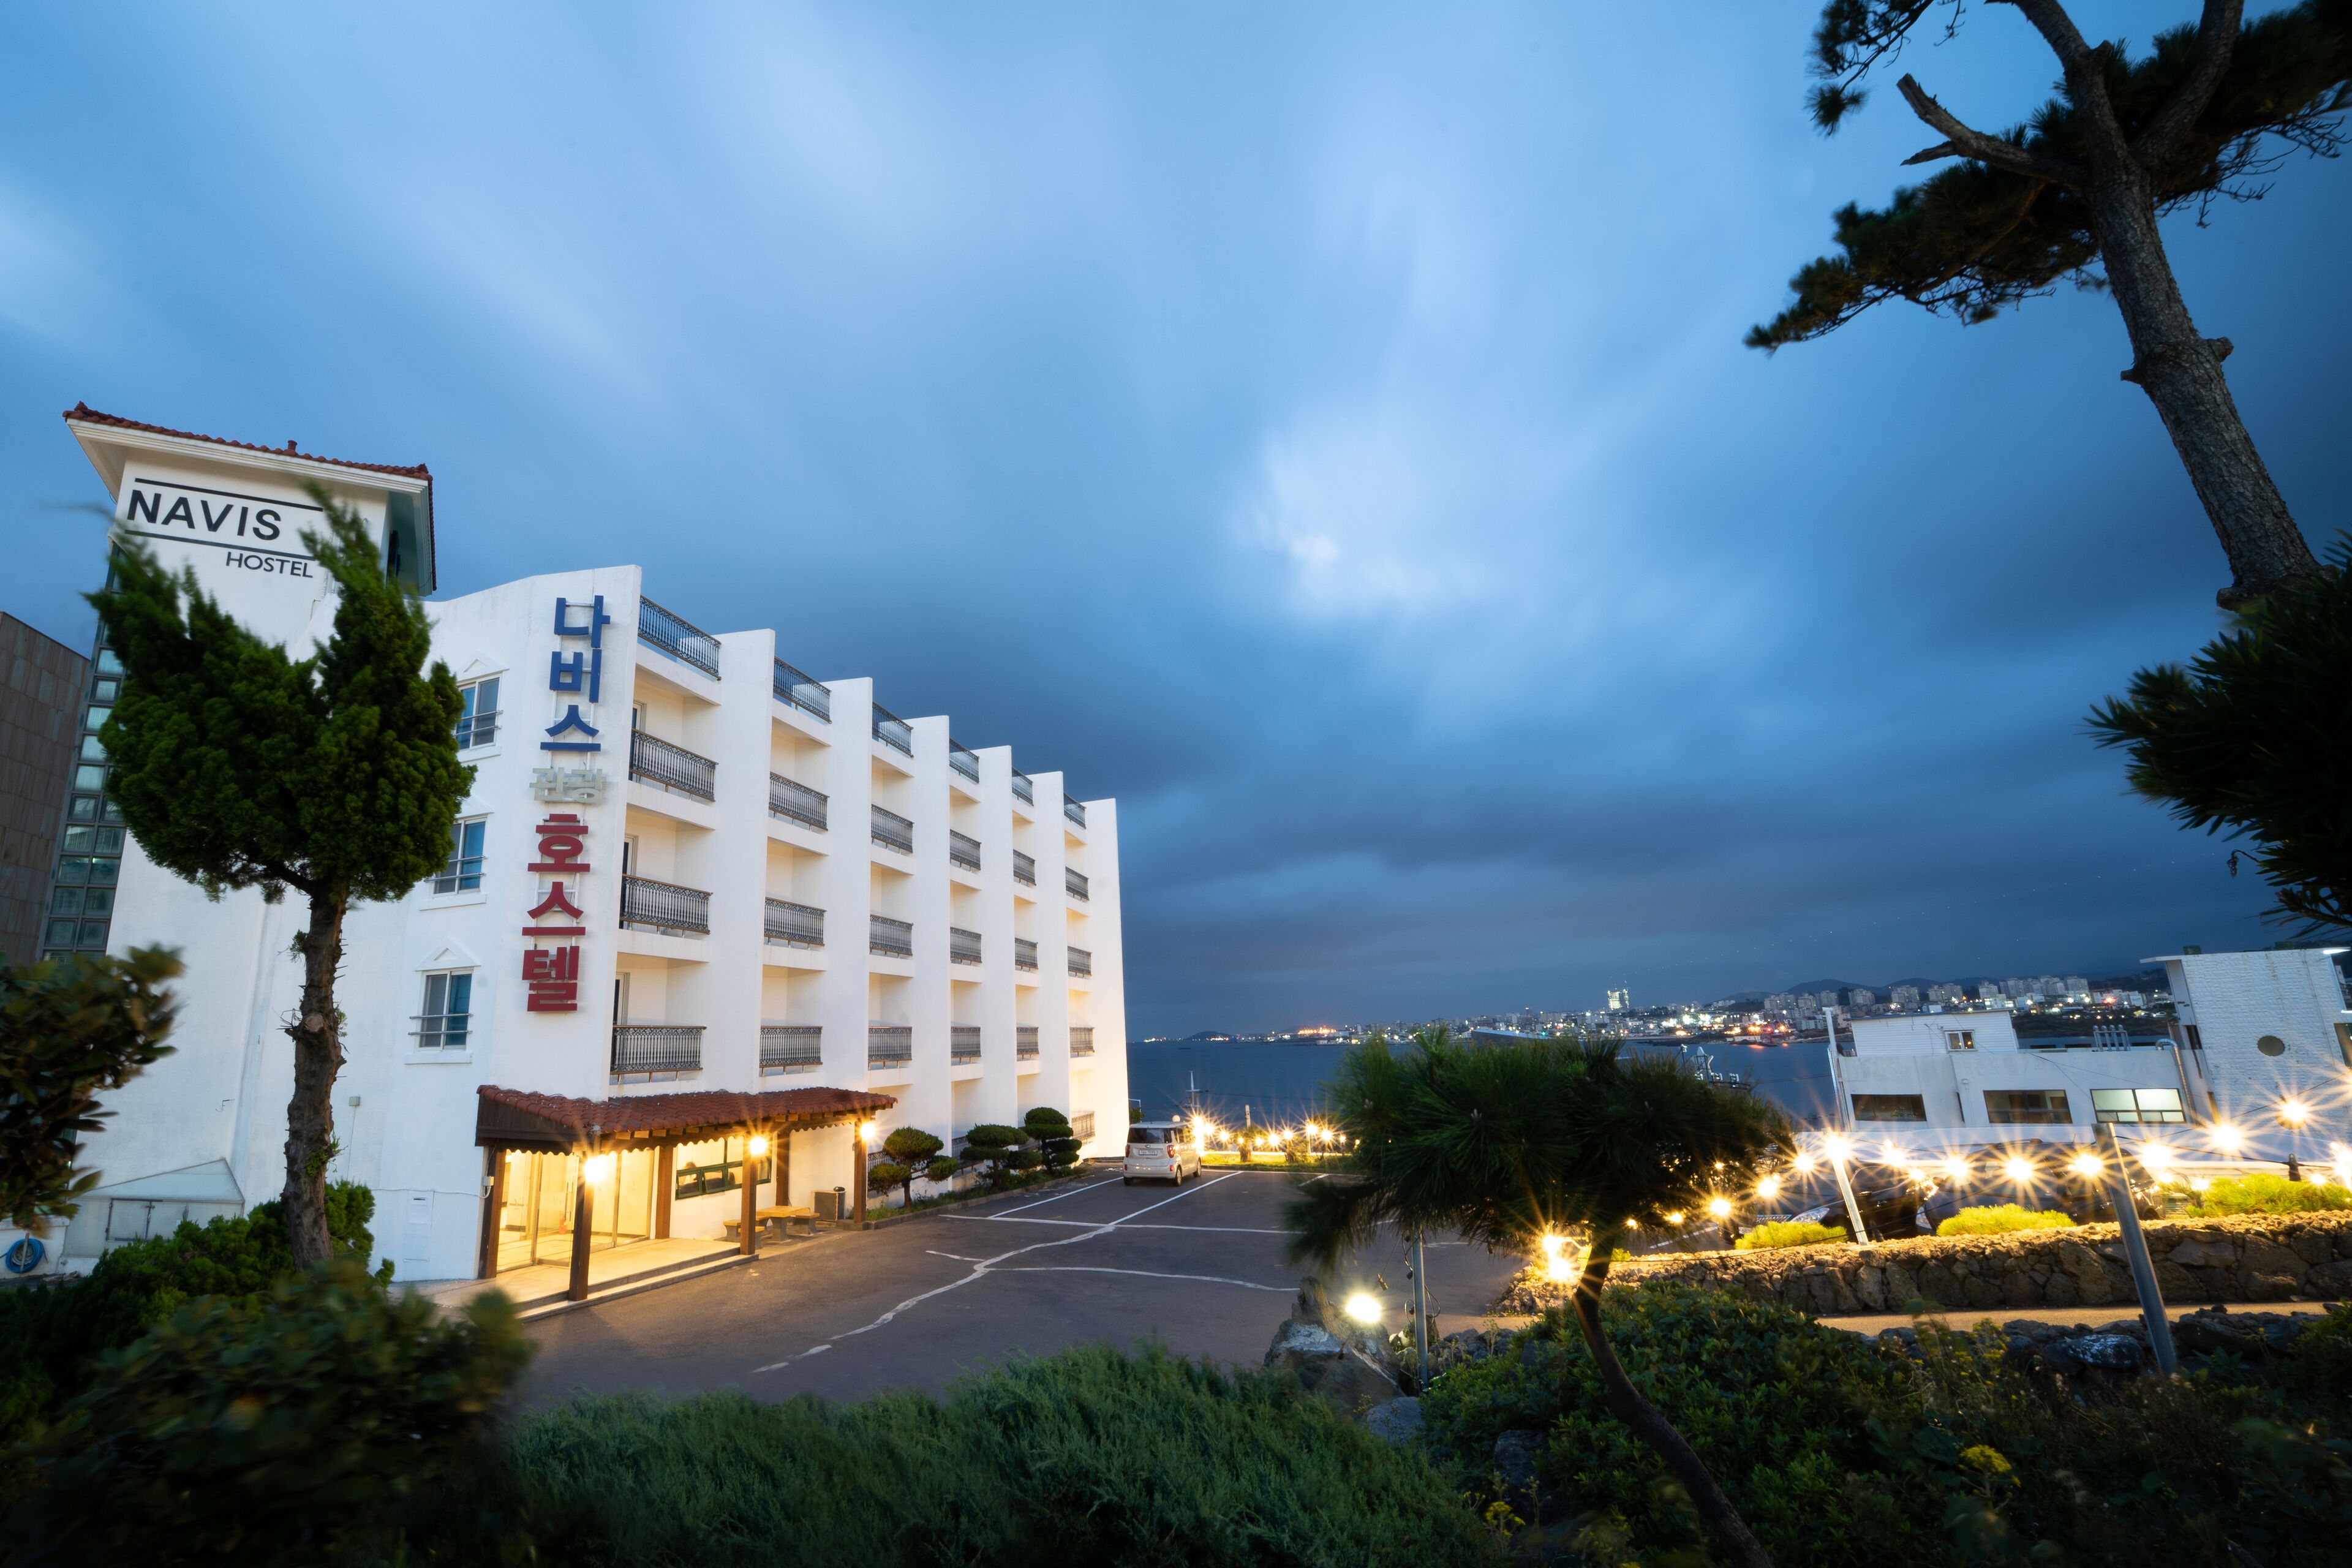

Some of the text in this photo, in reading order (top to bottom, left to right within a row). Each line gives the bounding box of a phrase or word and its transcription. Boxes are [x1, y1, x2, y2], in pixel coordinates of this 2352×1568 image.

[127, 489, 281, 541] NAVIS
[226, 551, 314, 578] HOSTEL
[522, 595, 611, 1012] 나비스 관광 호스텔
